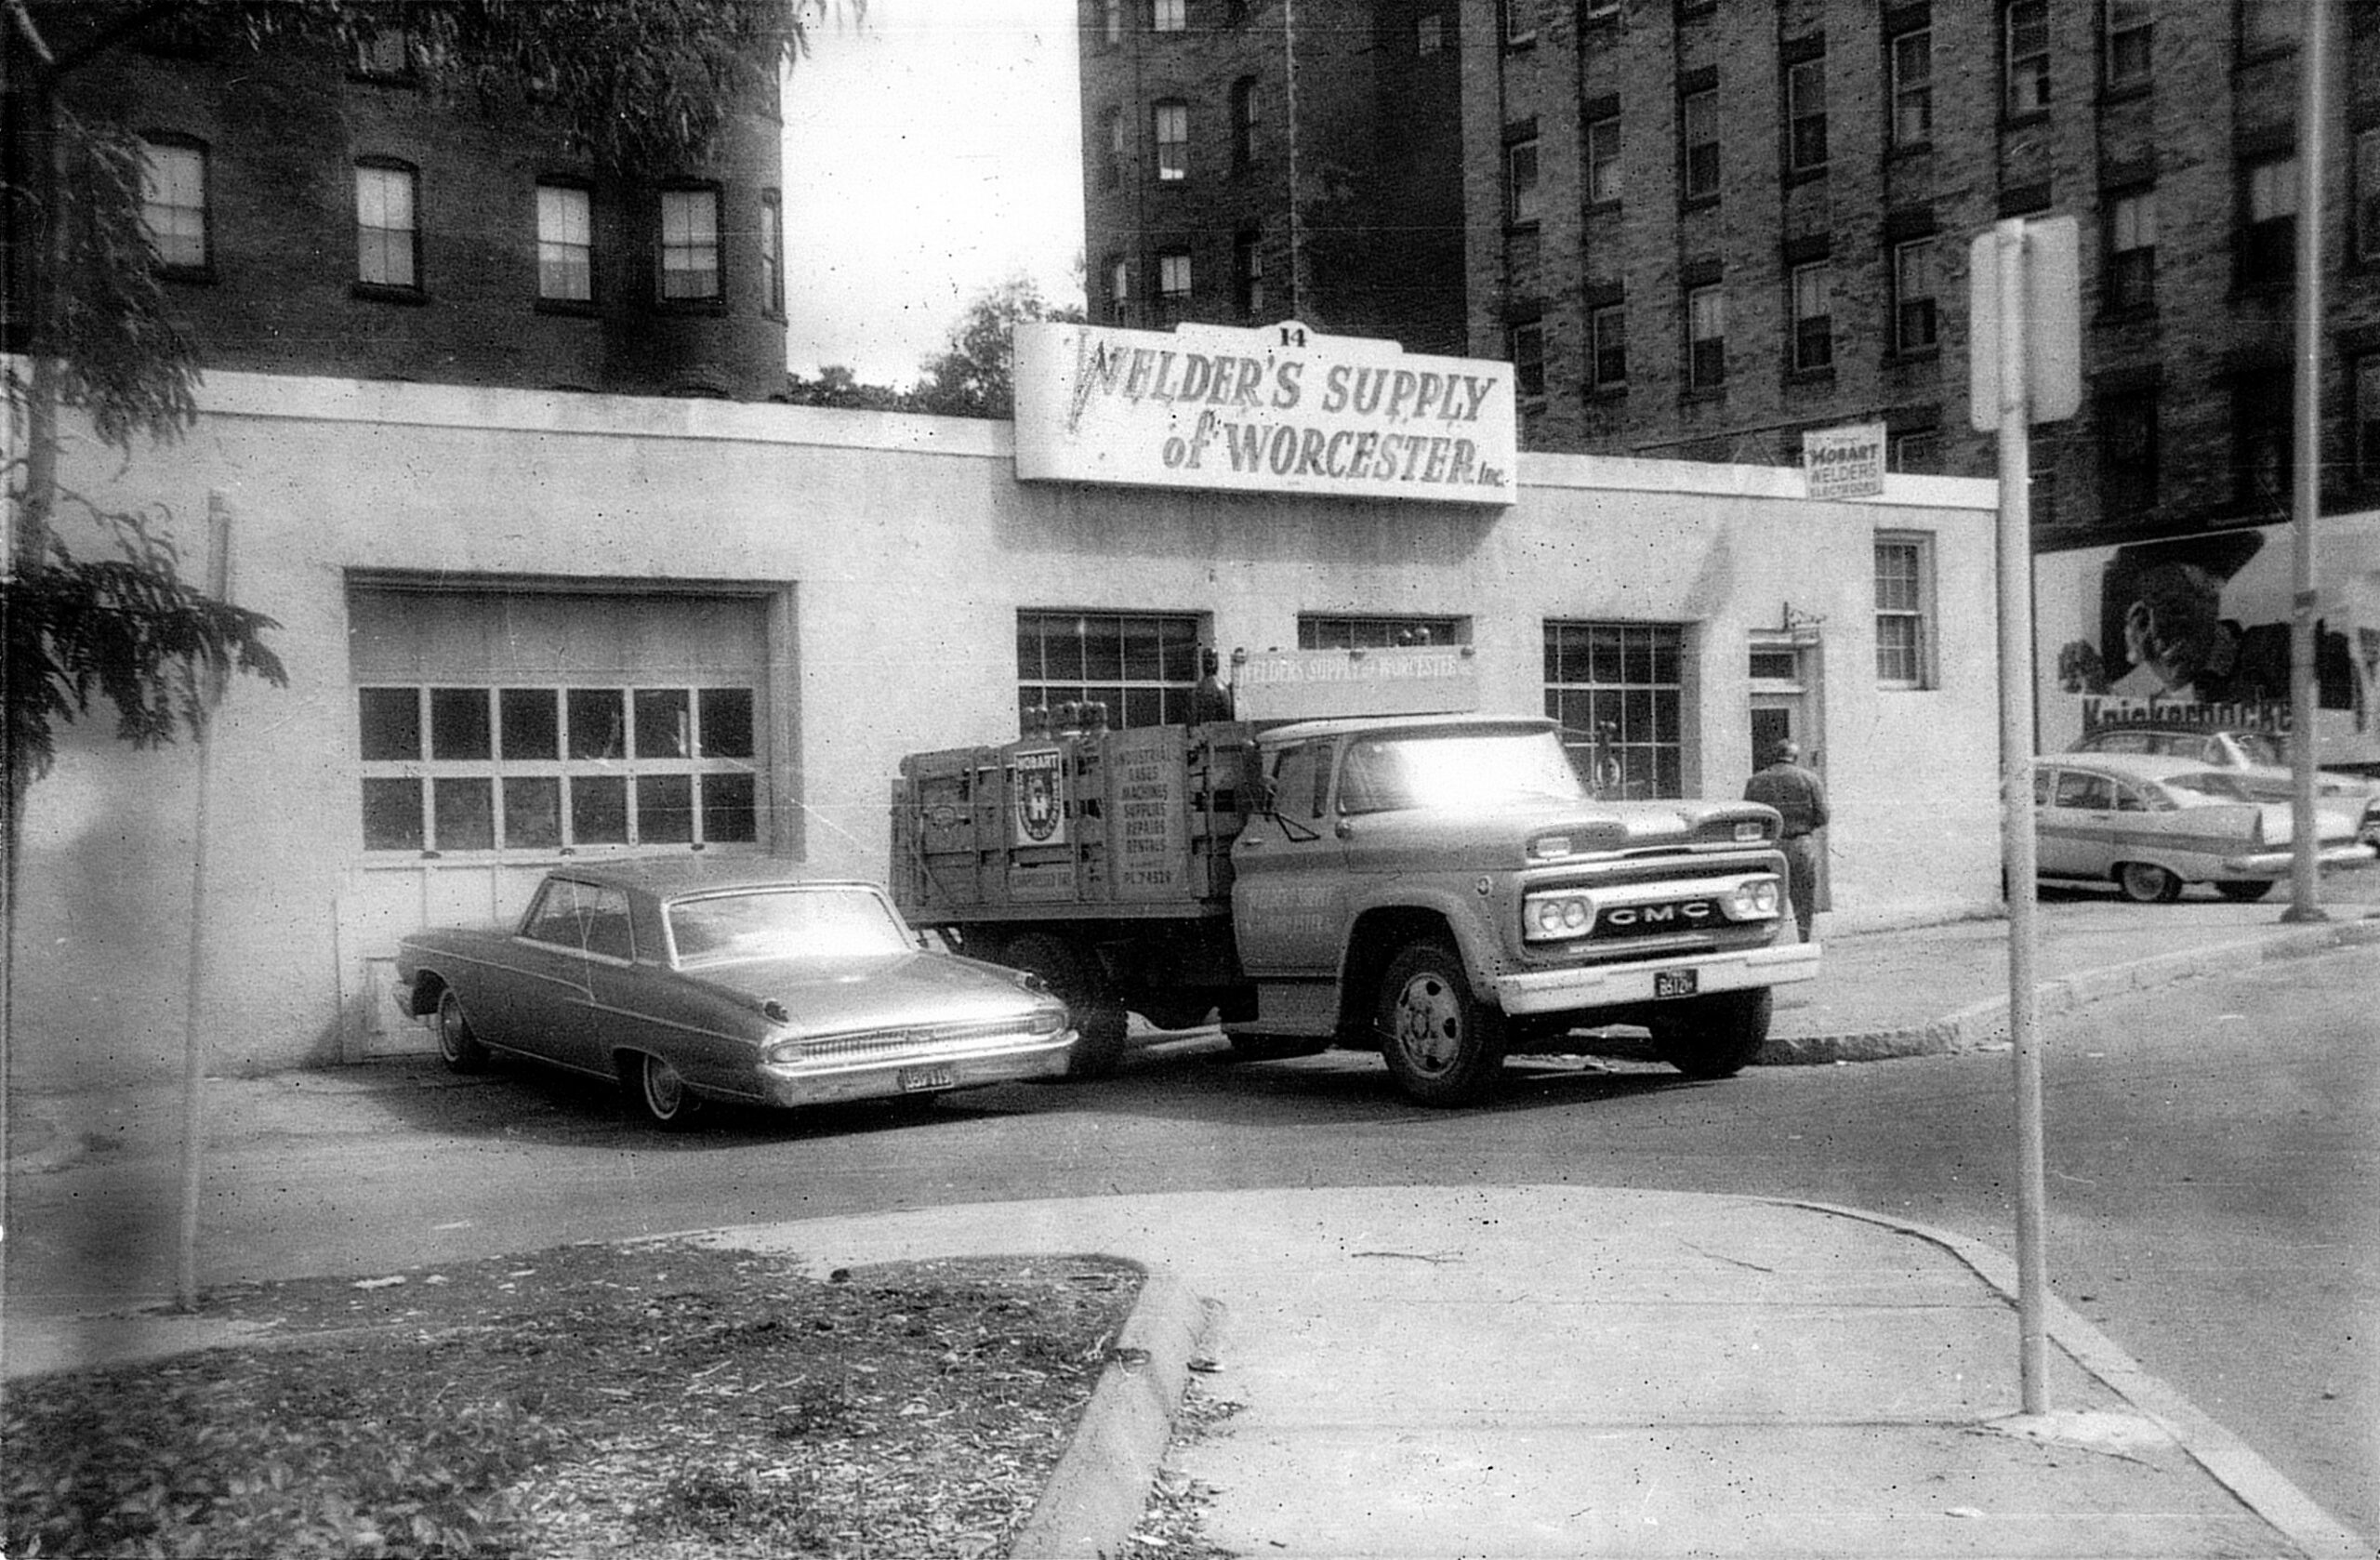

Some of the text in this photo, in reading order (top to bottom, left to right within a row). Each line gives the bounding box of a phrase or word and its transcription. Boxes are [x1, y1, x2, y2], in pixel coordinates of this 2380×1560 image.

[1279, 326, 1306, 348] 14
[1067, 328, 1498, 435] WELDER'S SUPPLY
[1223, 421, 1475, 485] WORCESTER
[1808, 443, 1878, 467] HOBART
[1810, 461, 1878, 483] WELDERS
[1607, 902, 1710, 924] GMC
